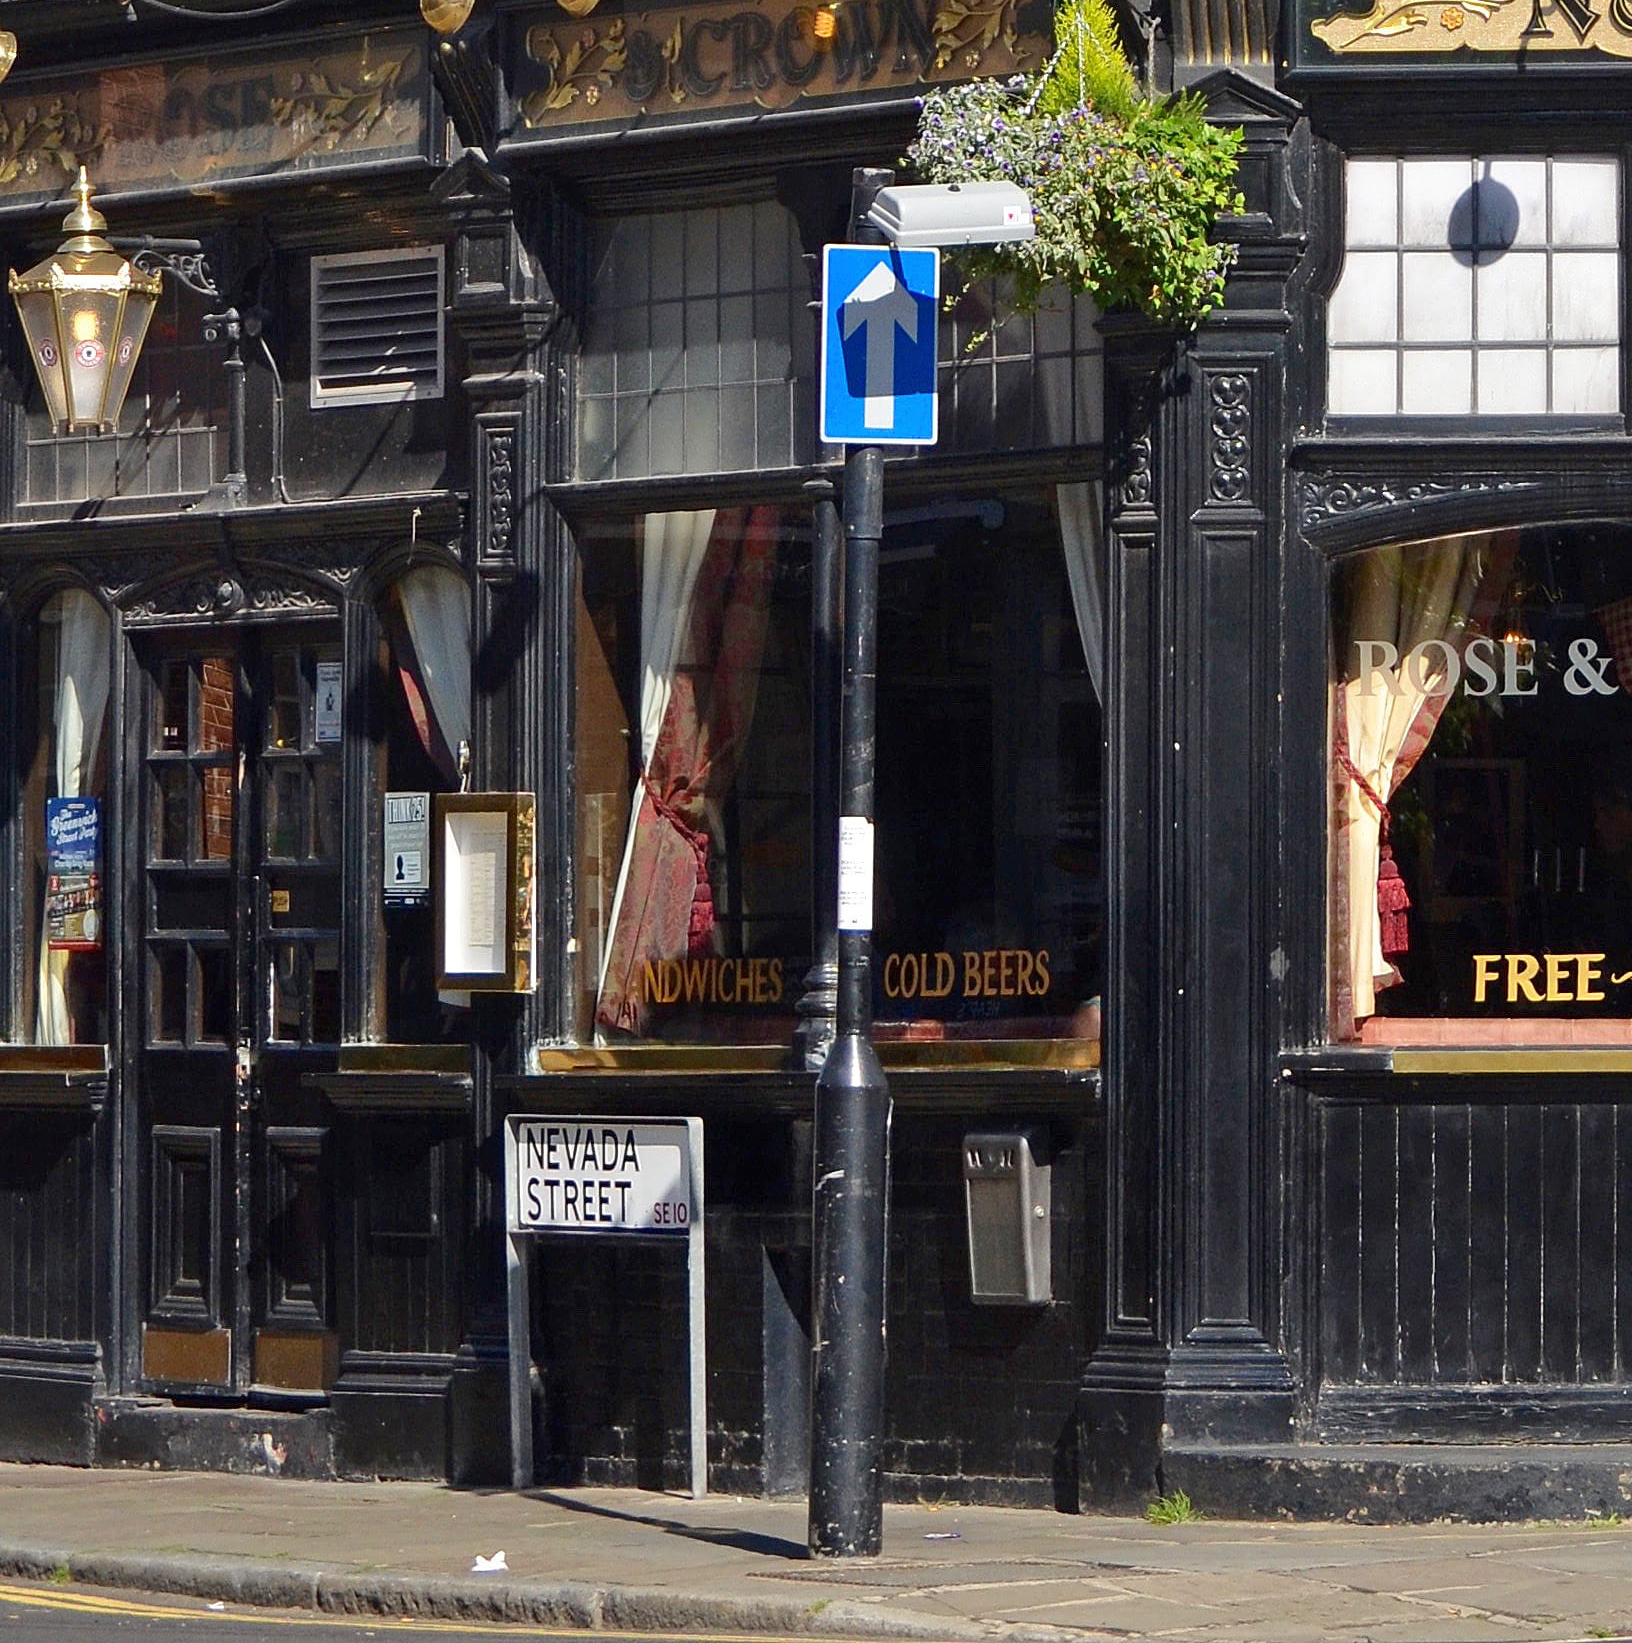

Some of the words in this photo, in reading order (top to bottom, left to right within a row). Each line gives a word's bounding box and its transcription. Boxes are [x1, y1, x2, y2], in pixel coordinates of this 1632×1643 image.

[1354, 639, 1538, 696] ROSE
[1563, 637, 1620, 695] &
[643, 957, 785, 1005] NDWICHES
[884, 952, 956, 999] COLD
[963, 949, 1050, 997] BEERS
[1473, 953, 1605, 1002] FREE
[526, 1129, 640, 1172] NEVADA
[526, 1177, 632, 1223] STREET
